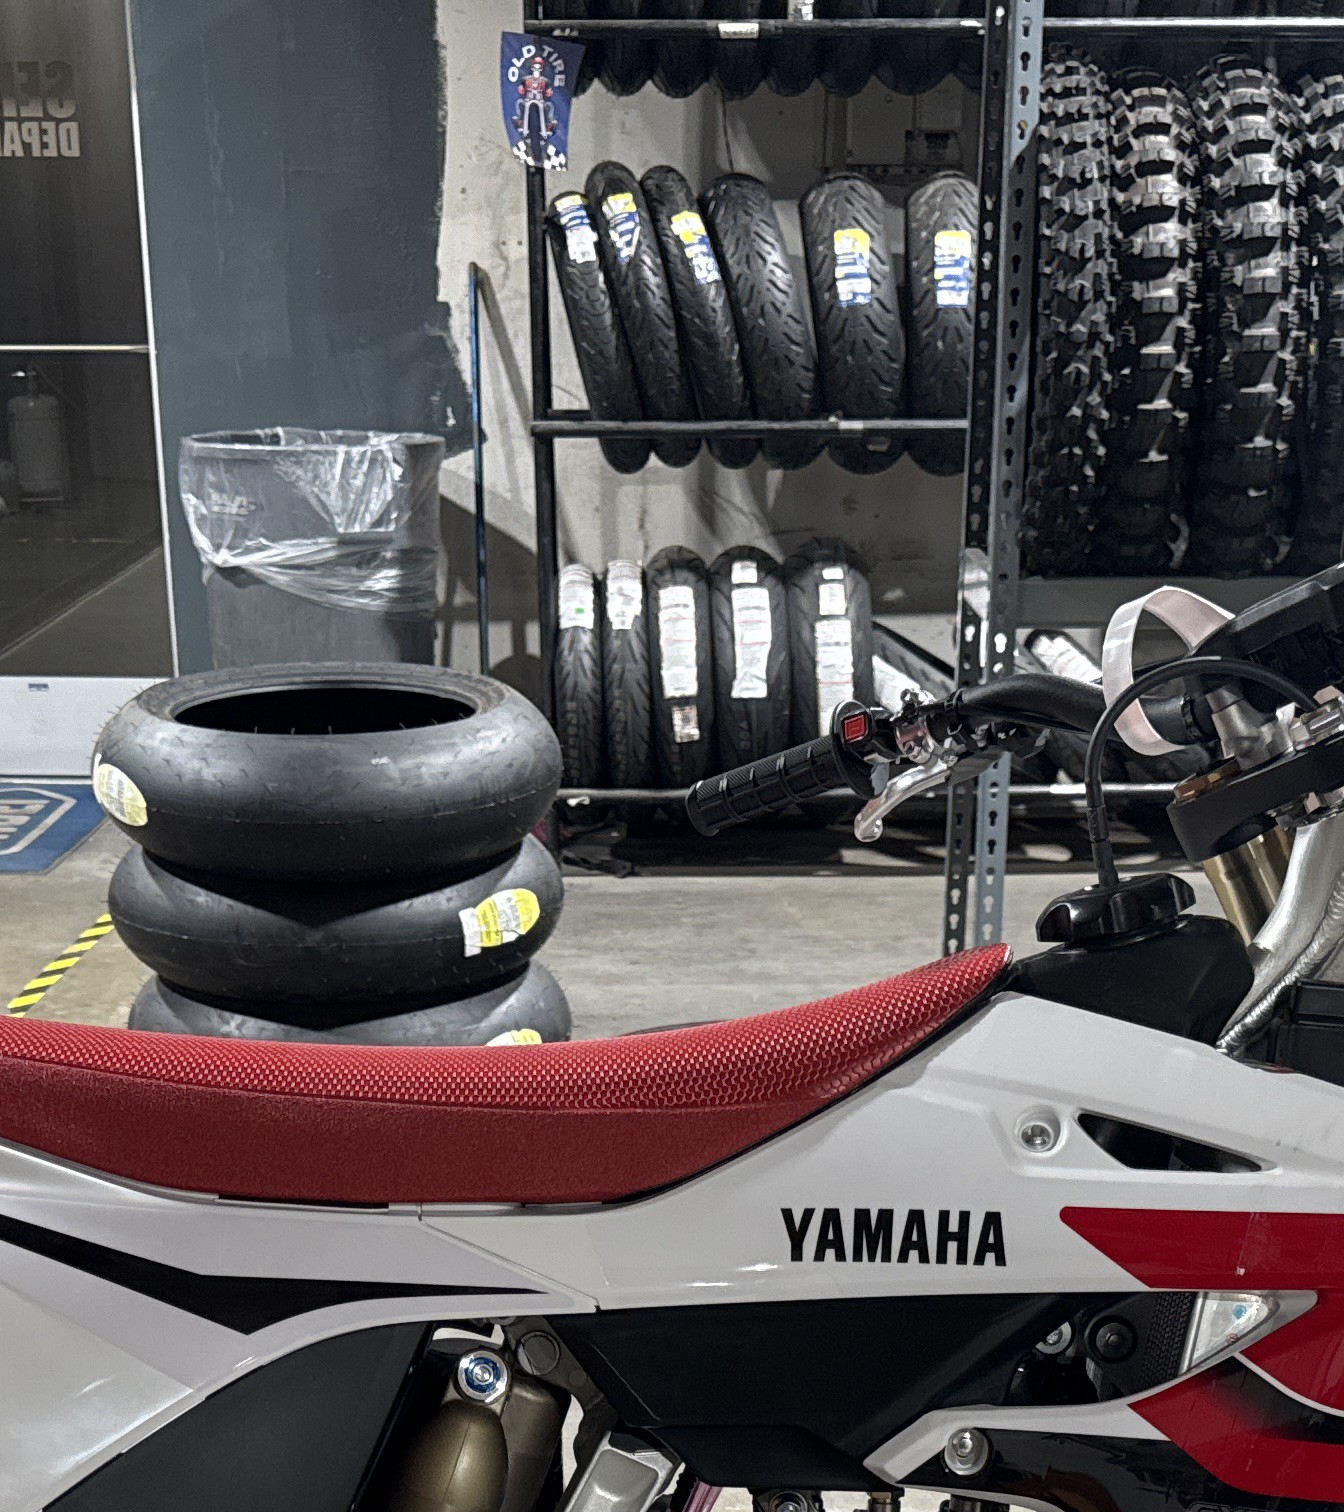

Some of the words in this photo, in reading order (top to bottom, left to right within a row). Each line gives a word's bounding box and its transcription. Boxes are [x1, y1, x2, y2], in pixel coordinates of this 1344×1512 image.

[508, 45, 536, 82] OLD
[542, 45, 566, 87] TIRE
[781, 1208, 1007, 1267] YAMAHA
